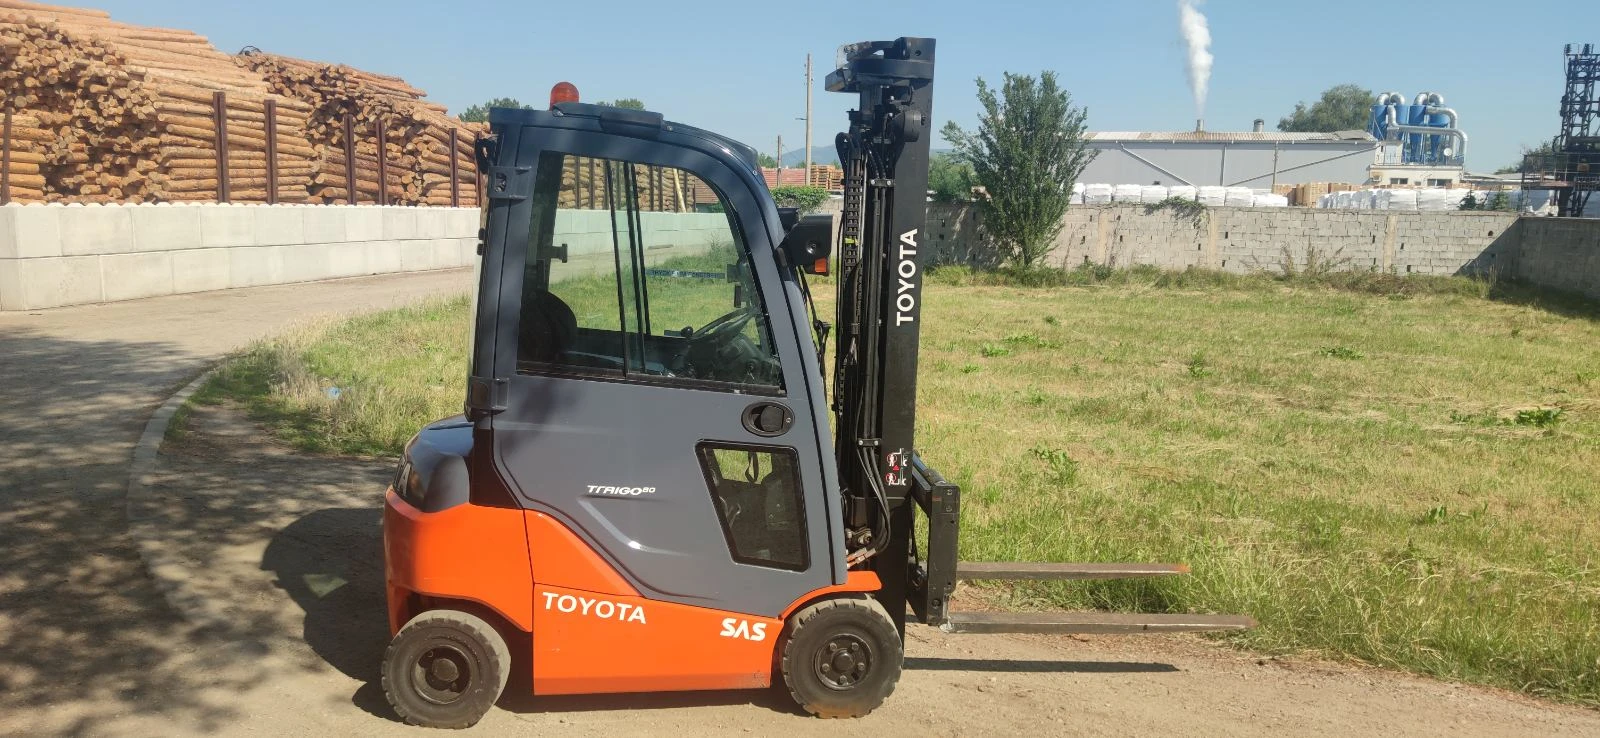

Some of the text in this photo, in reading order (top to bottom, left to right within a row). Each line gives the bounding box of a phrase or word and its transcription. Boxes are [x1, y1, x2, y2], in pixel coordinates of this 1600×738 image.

[896, 228, 918, 326] TOYOTA
[542, 591, 647, 624] TOYOTA
[719, 617, 767, 641] SAS
